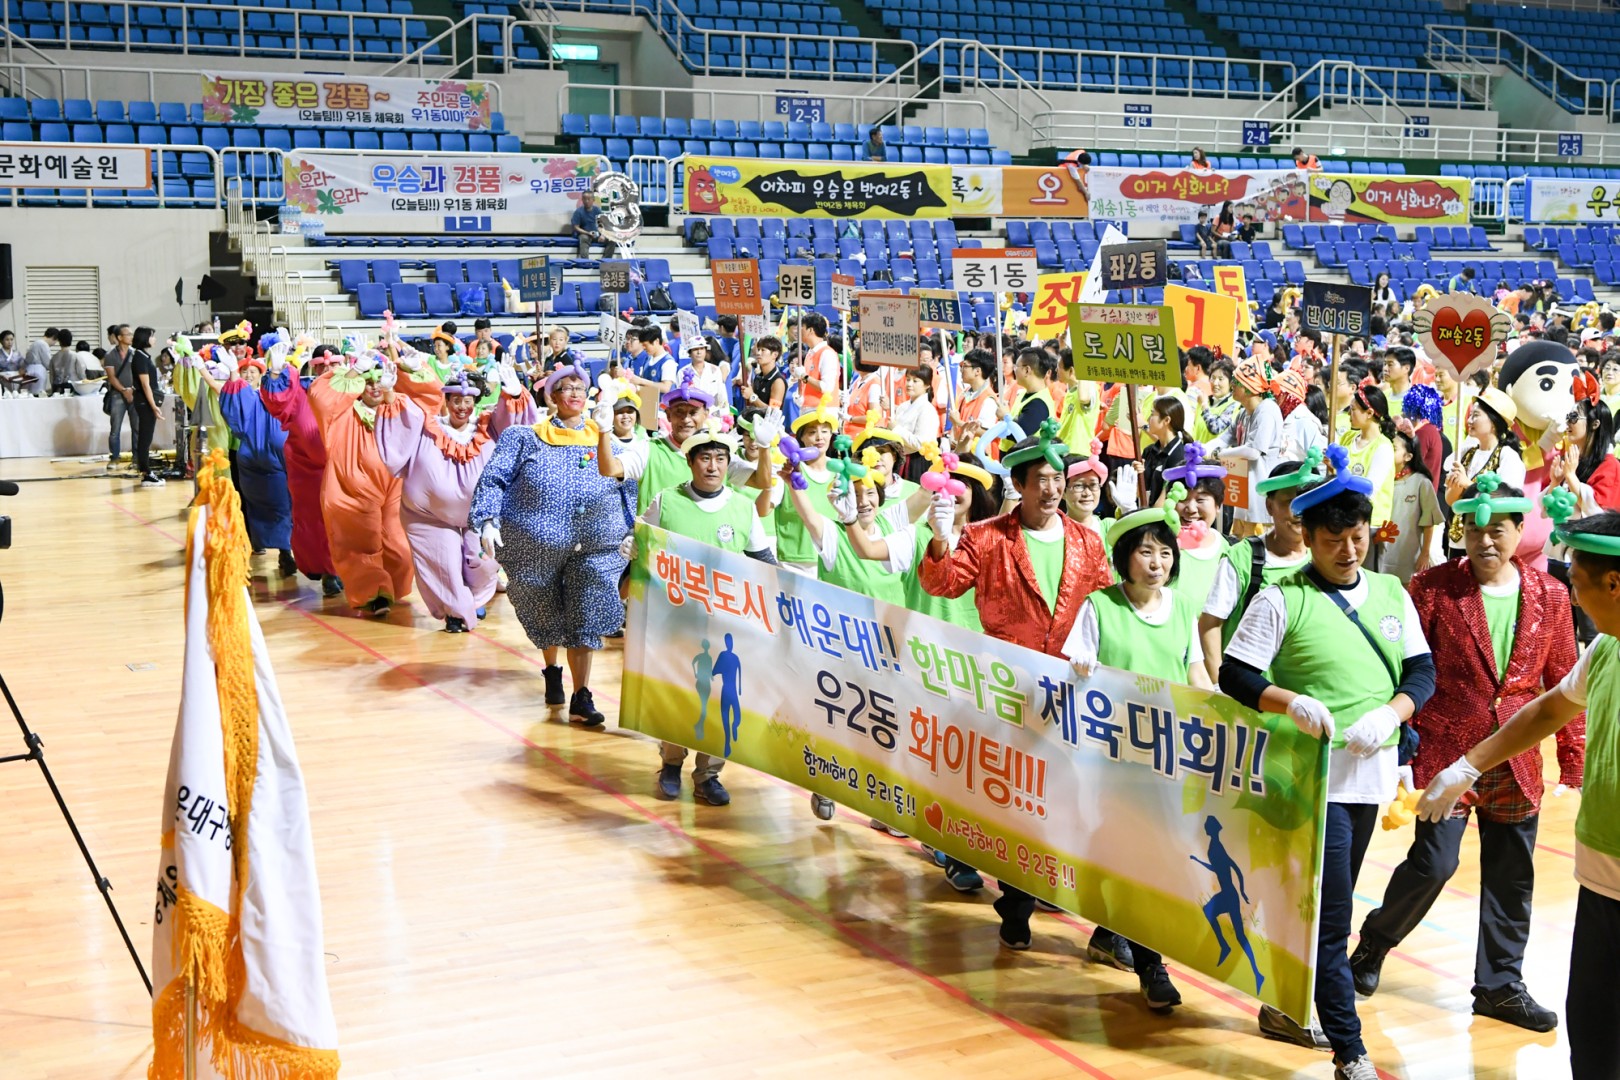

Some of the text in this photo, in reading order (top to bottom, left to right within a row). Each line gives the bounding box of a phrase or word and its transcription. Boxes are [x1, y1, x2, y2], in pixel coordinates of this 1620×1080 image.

[219, 79, 267, 107] 가장
[272, 80, 319, 108] 좋은
[324, 82, 370, 110] 경품
[417, 91, 471, 109] 주인공은
[298, 110, 405, 124] (오늘팀!!) 우1동 체육회
[795, 108, 821, 123] 2-3
[1246, 130, 1266, 144] 2-4
[1561, 142, 1579, 155] 2-5
[372, 164, 447, 194] 우승과
[453, 165, 501, 194] 경품
[760, 175, 806, 194] 어차피
[812, 179, 855, 200] 우승은
[1133, 174, 1230, 199] 이거 실화냐?
[391, 198, 508, 212] (오늘팀!!) 우1동 체육회
[815, 200, 866, 210] 반여2동 체육회
[1365, 188, 1393, 204] 이거
[1395, 187, 1442, 211] 실화냐?
[963, 263, 1027, 288] 중1동
[1109, 251, 1156, 281] 좌2동
[603, 271, 626, 288] 송정동
[718, 277, 755, 297] 오늘팀
[780, 273, 814, 300] 우1동
[1306, 305, 1363, 333] 반여1동
[1083, 331, 1168, 364] 도시팀
[1438, 325, 1485, 348] 재송2동
[656, 550, 1269, 795] 행복도시 해운대!! 한마음 체육대회!!
[814, 670, 1047, 817] 우2동 화이팅!!!
[803, 745, 1076, 889] 함께해요 우리동!! 사랑해요 우2동!!
